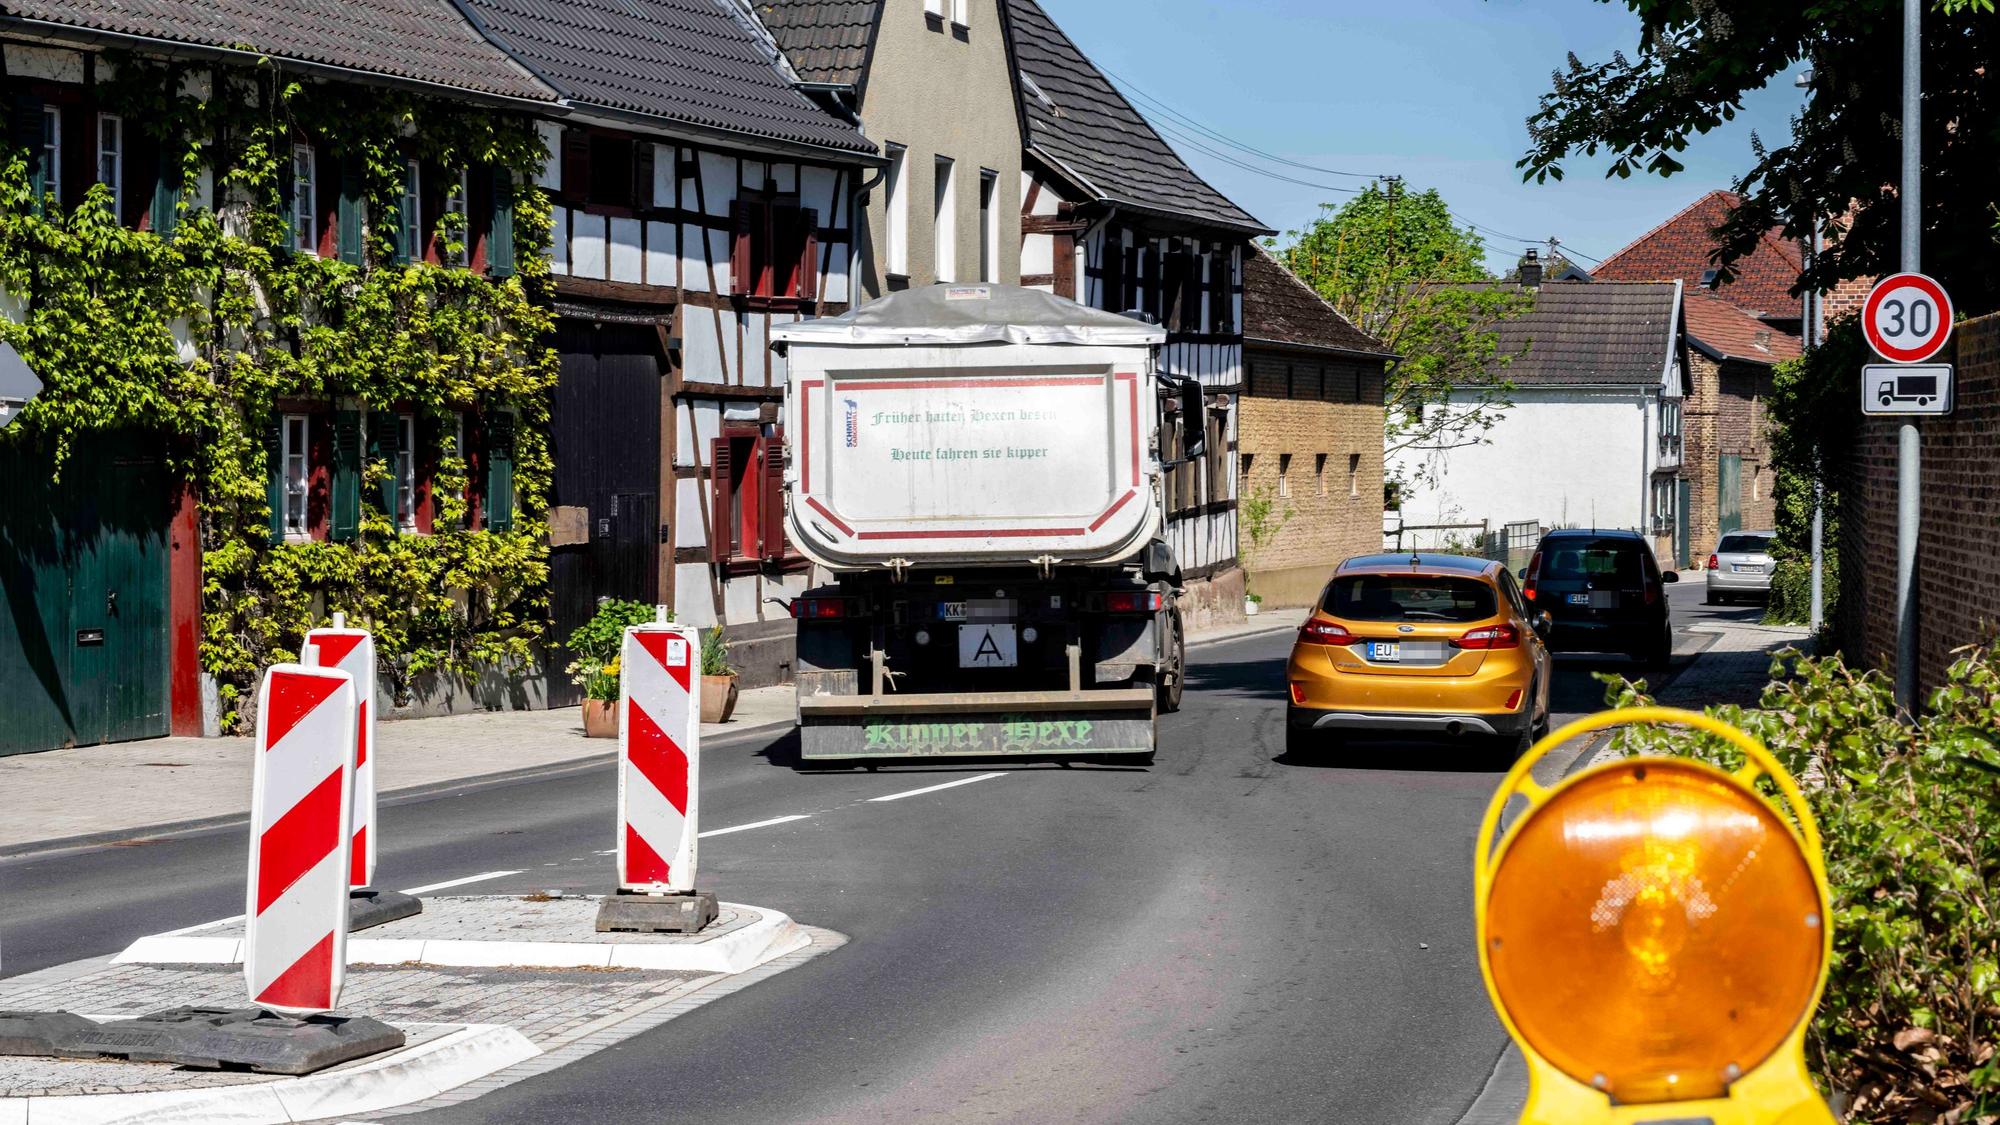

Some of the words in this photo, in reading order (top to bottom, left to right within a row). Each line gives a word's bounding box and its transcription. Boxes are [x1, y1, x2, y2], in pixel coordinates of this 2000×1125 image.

[1883, 299, 1932, 338] 30
[870, 411, 921, 426] Früher
[890, 447, 932, 462] Heute
[936, 447, 978, 461] fahren
[983, 448, 1002, 459] sie
[973, 628, 1003, 661] A
[863, 714, 985, 755] Kipper
